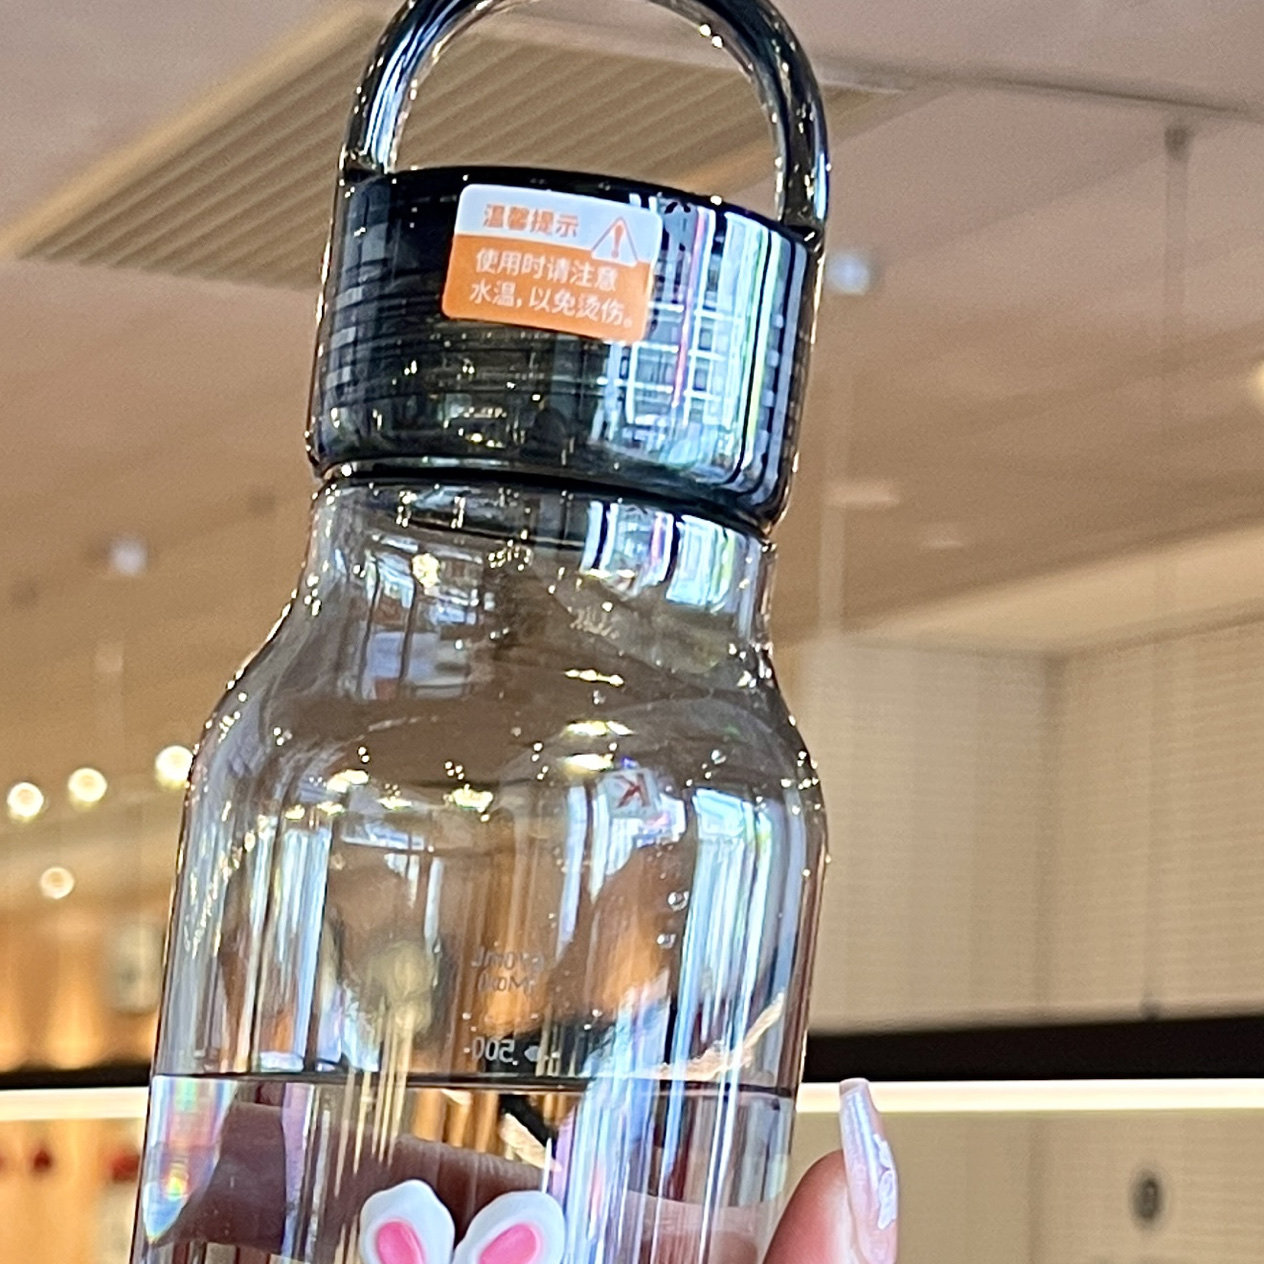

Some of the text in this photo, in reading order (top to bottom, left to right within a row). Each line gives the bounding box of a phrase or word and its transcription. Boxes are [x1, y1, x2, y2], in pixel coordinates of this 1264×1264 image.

[483, 204, 579, 237] 温馨提示
[476, 247, 619, 292] 使用时请注意
